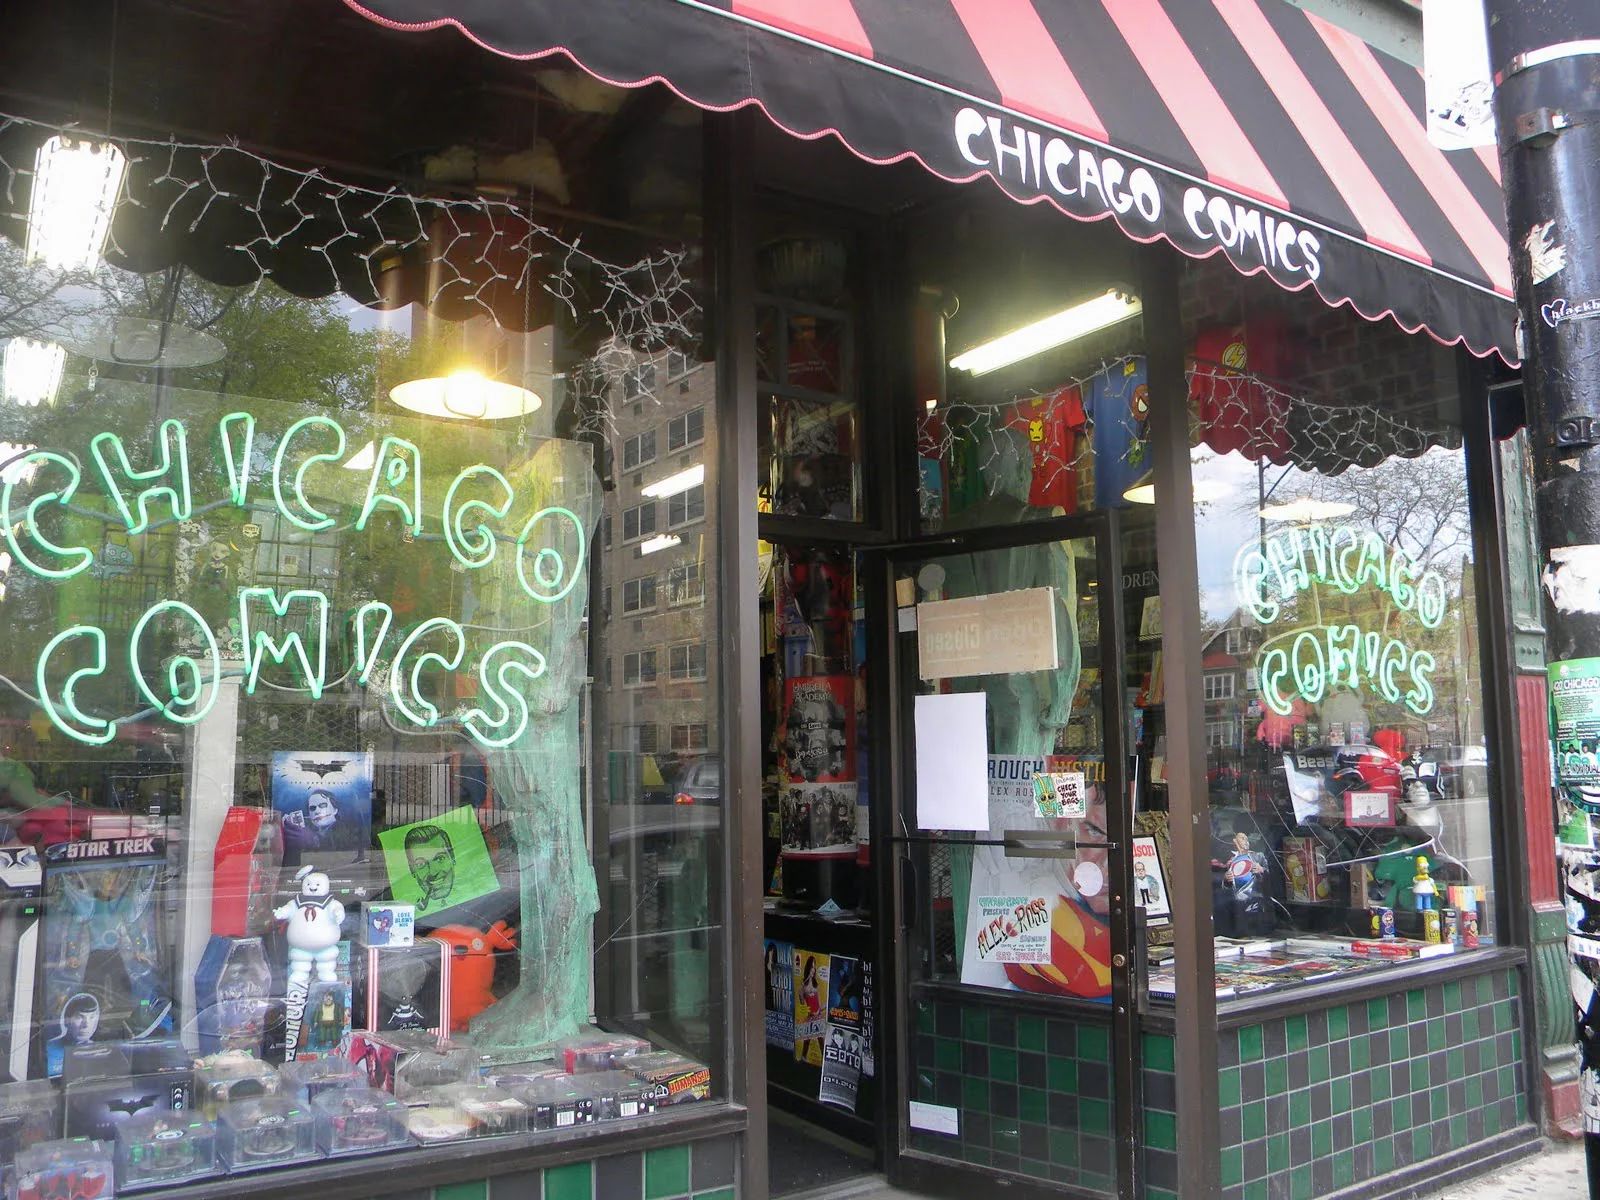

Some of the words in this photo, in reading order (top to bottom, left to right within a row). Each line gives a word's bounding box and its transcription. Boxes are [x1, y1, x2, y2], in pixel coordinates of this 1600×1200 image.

[954, 107, 1161, 222] CHICAGO
[1183, 187, 1320, 280] COMICS
[1, 411, 586, 602] CHICAGO
[1234, 525, 1446, 628] CHICAGO
[37, 587, 547, 748] COMICS
[1262, 624, 1436, 716] COMICS
[1057, 783, 1077, 793] CHECK
[1060, 791, 1077, 799] YOUR
[1061, 797, 1079, 806] BAGS
[66, 840, 109, 858] STAR
[114, 839, 155, 855] TREK
[977, 915, 1008, 959] ALEX
[1015, 897, 1048, 933] ROSS
